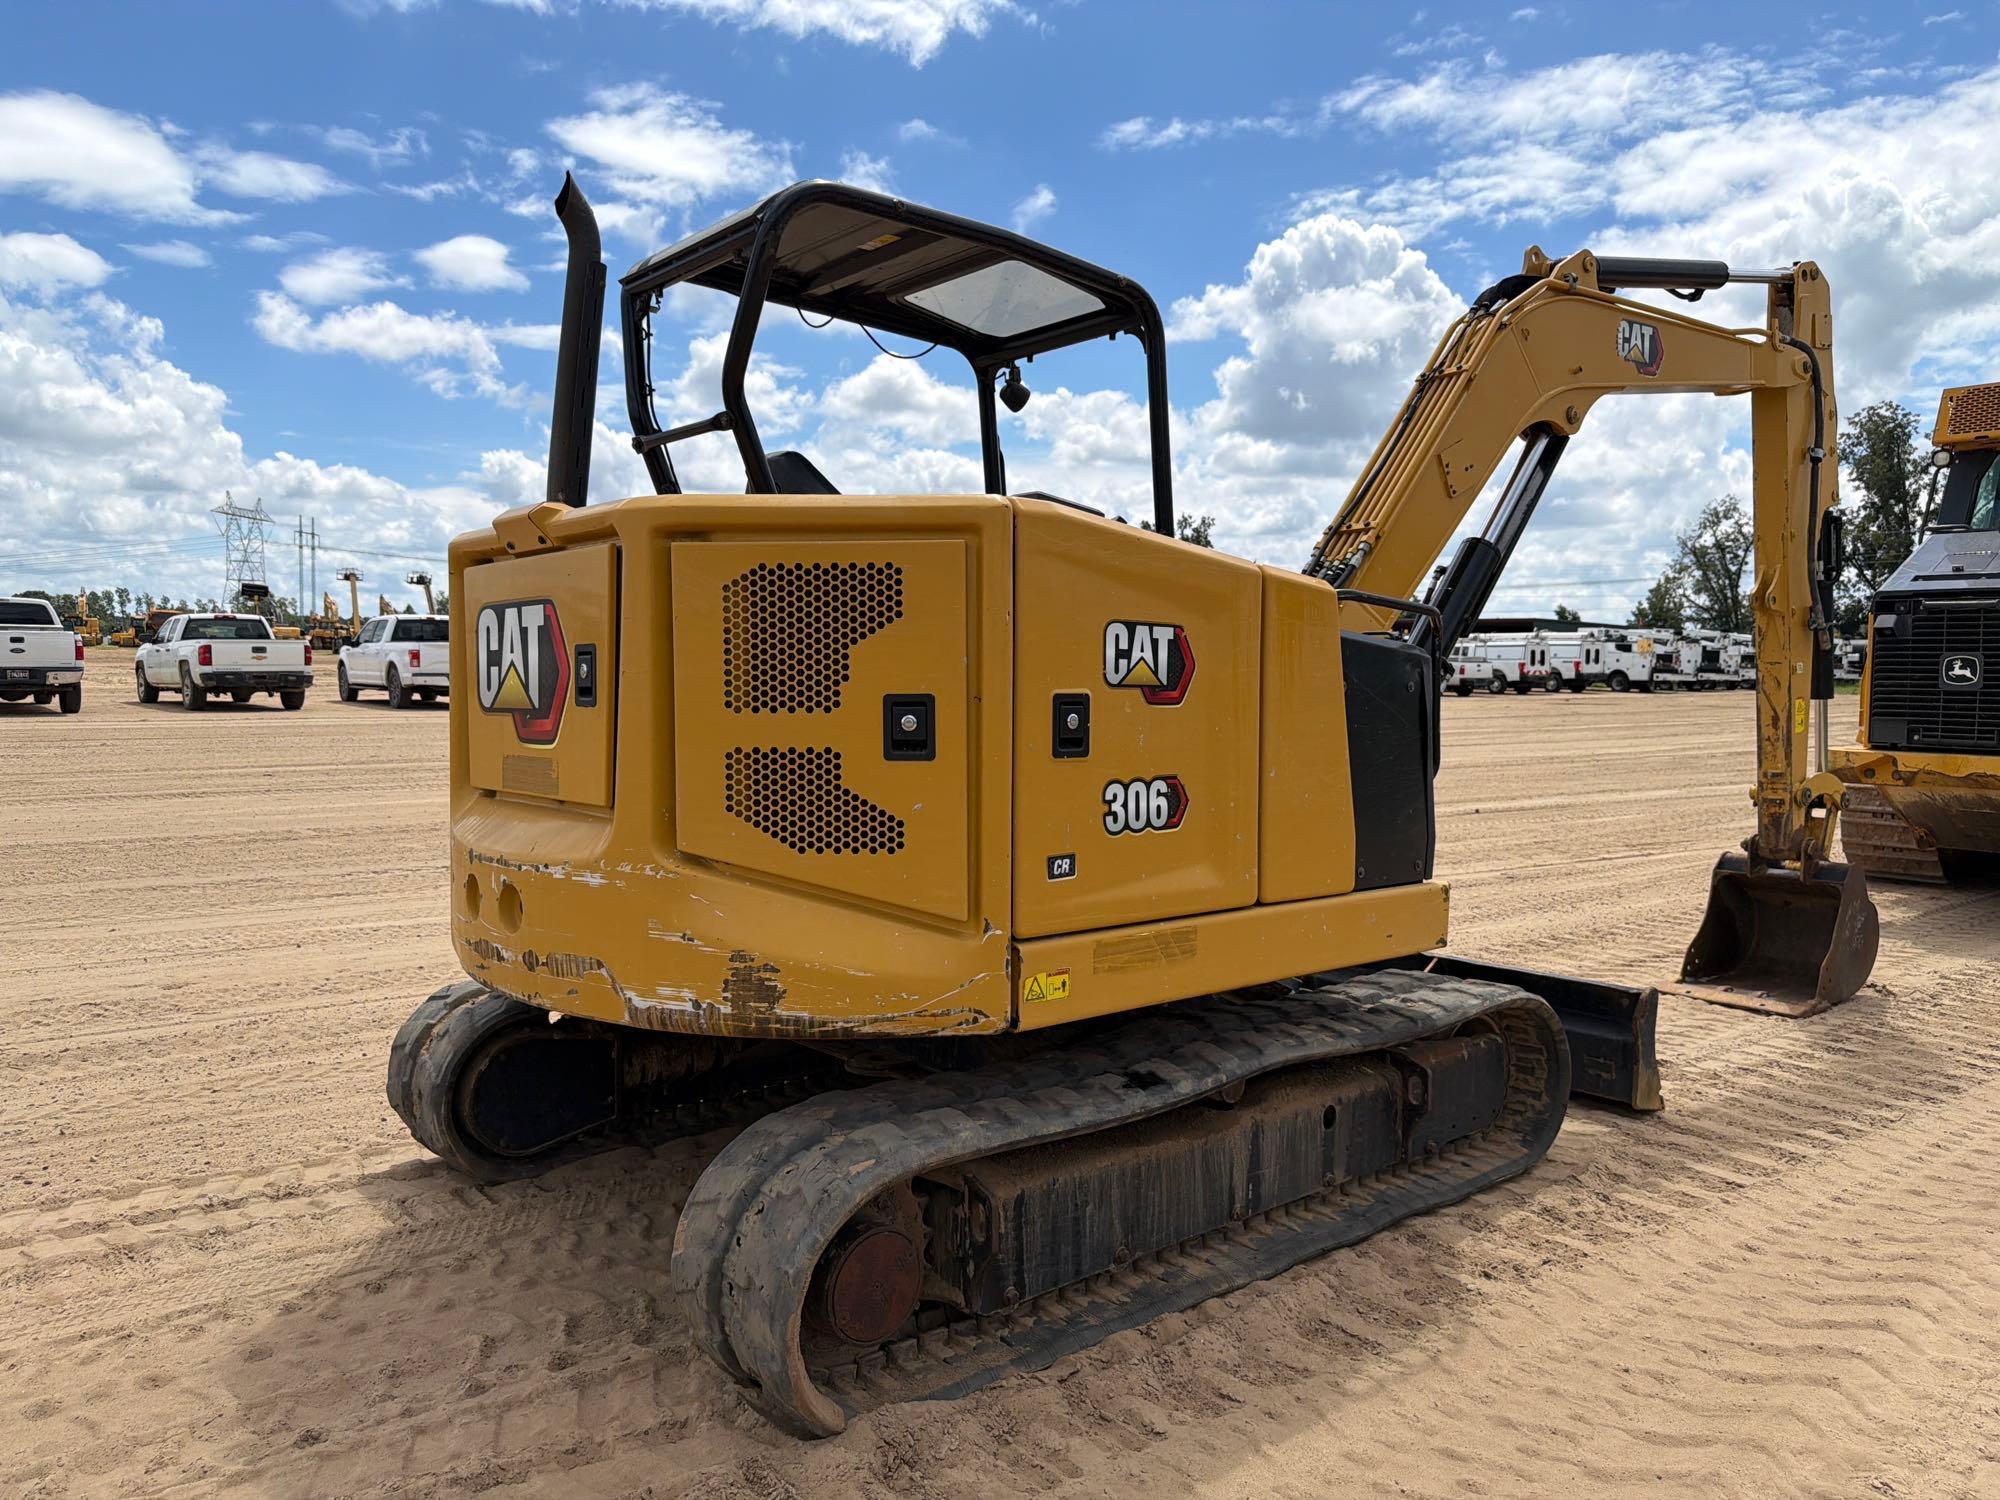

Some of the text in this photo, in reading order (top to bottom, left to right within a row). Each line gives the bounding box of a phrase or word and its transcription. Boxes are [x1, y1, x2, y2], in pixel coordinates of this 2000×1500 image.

[1617, 320, 1653, 364] CAT
[478, 604, 545, 709] CAT
[1105, 622, 1174, 686] CAT
[1105, 779, 1168, 832] 306
[1053, 858, 1070, 875] CR
